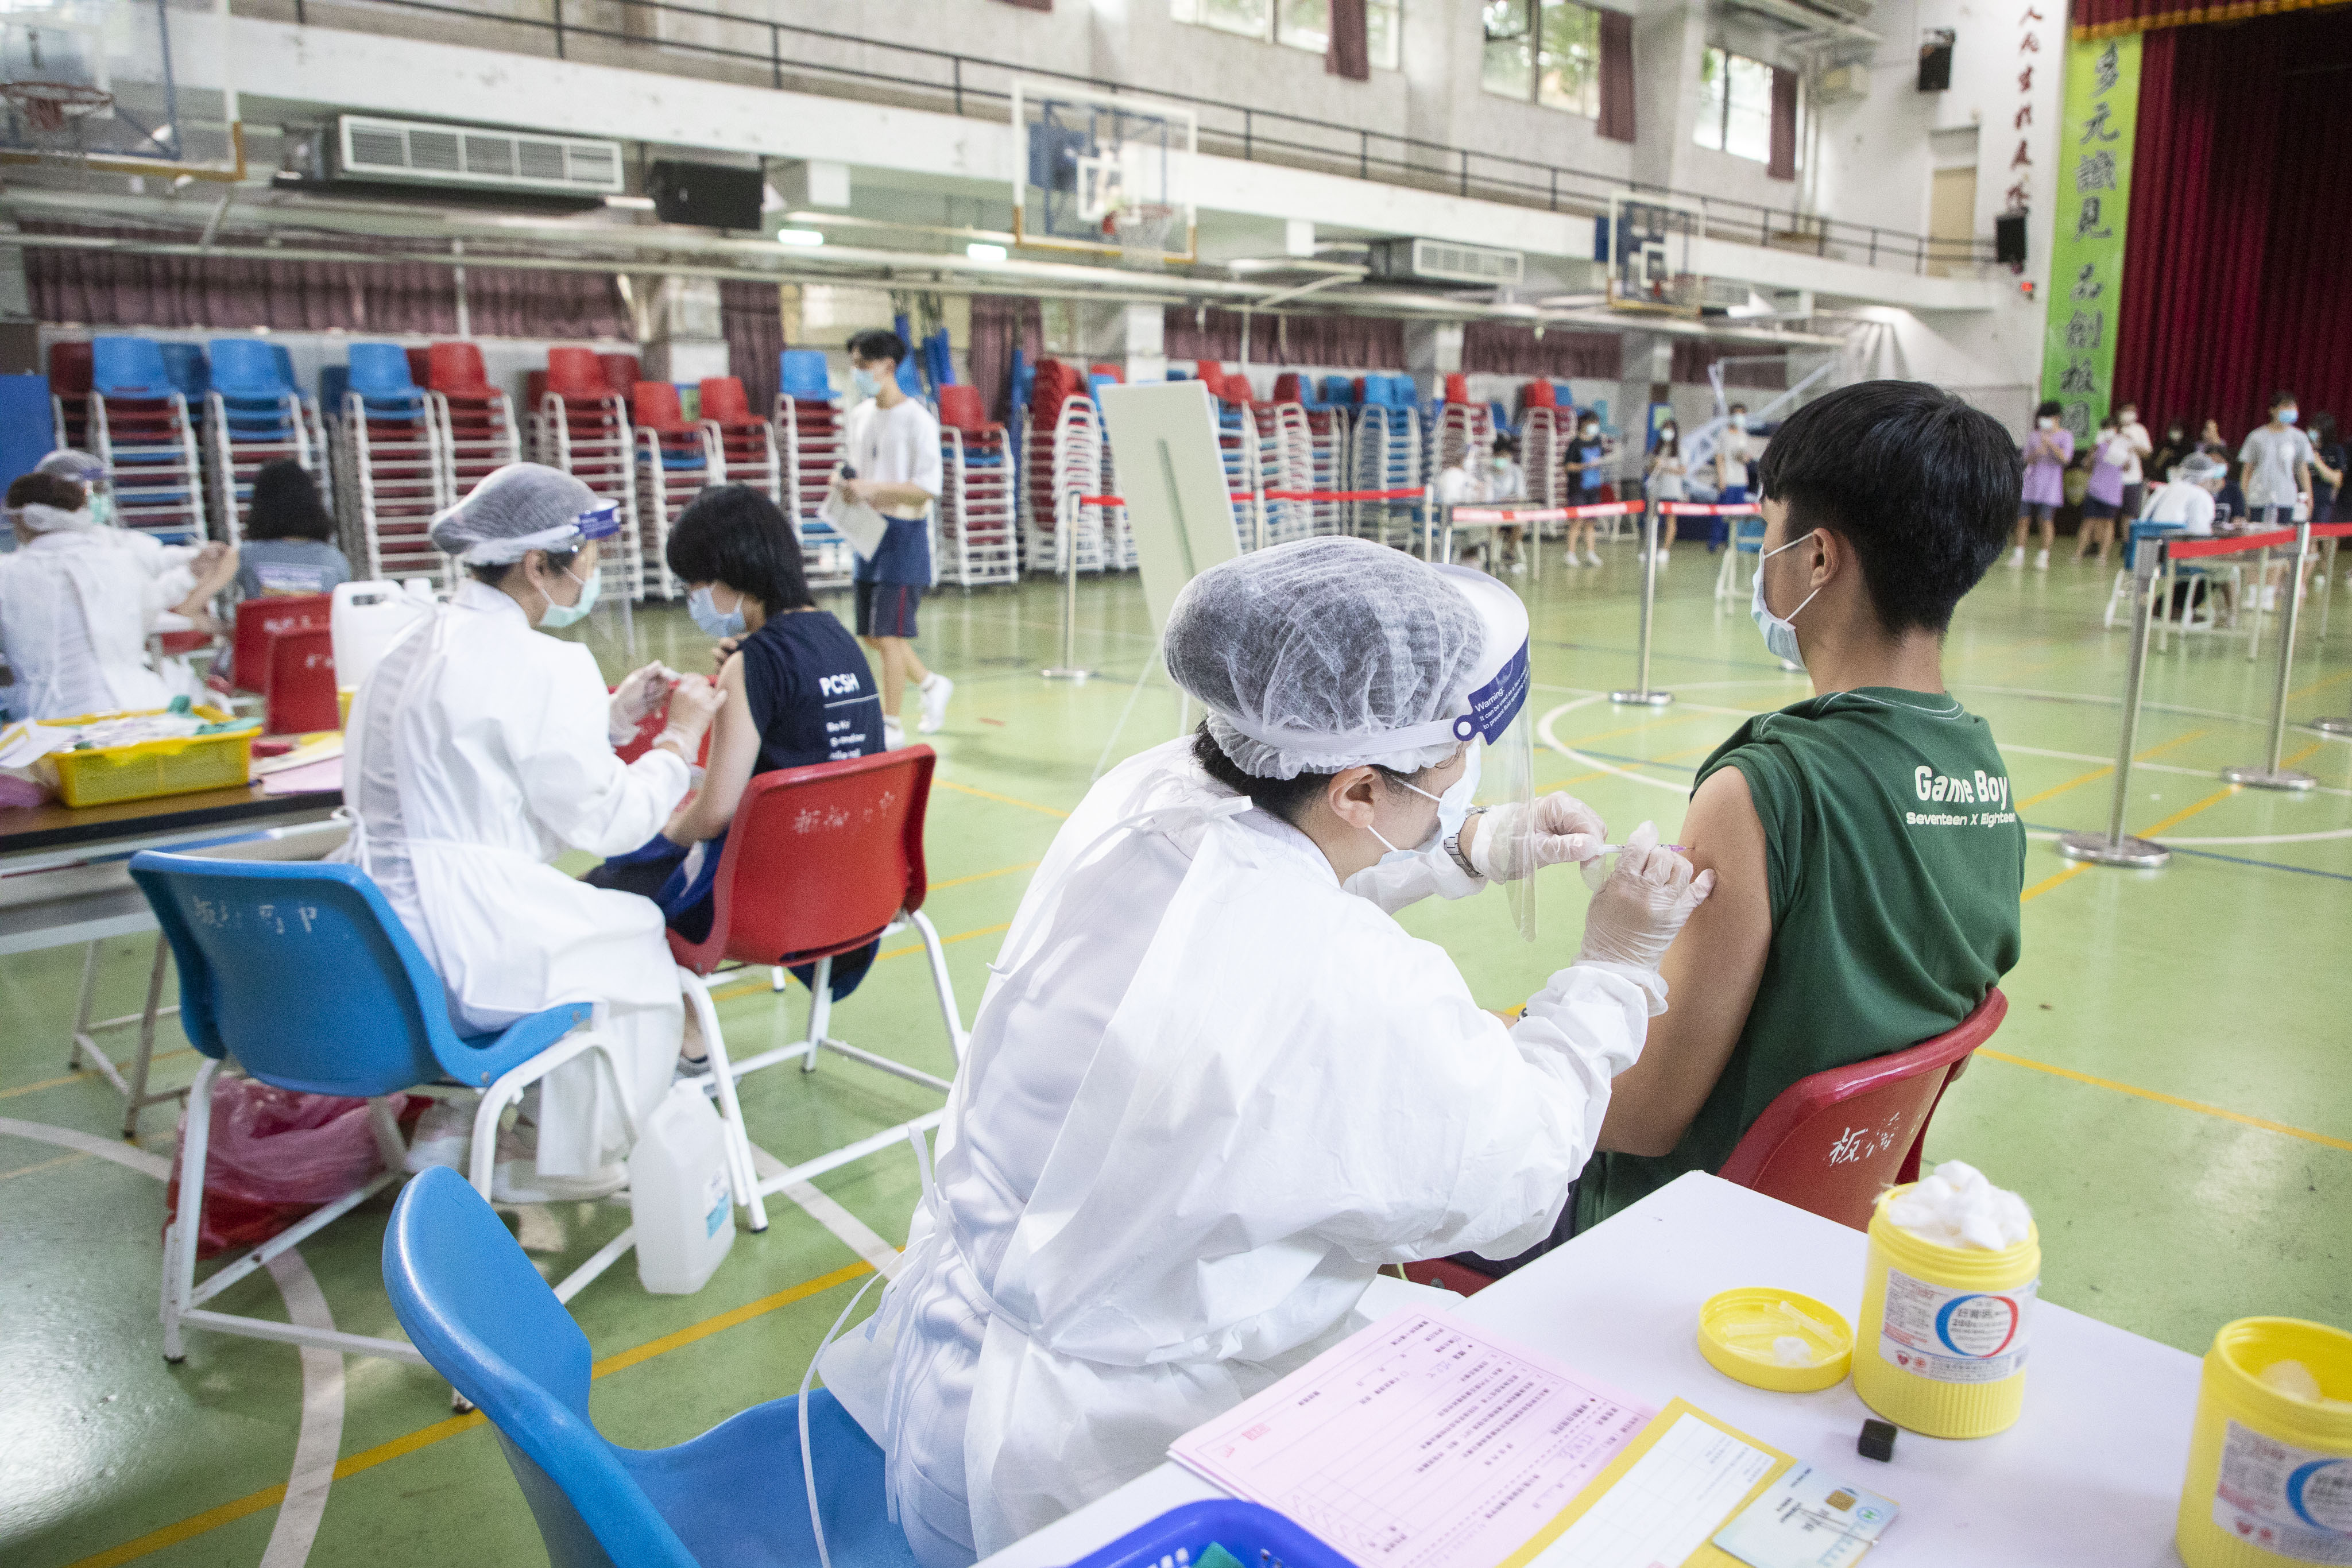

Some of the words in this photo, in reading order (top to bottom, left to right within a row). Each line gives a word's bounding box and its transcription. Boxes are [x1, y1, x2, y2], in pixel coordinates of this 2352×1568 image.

[819, 672, 860, 697] PCSH
[1475, 687, 1505, 712] Warning:
[1484, 708, 1495, 718] can
[1494, 702, 1500, 712] be
[1490, 709, 1504, 727] prevent
[1915, 765, 1975, 803] Game
[1974, 770, 2007, 810] Boy
[1906, 812, 1968, 826] Seventeen
[1970, 813, 1979, 825] X
